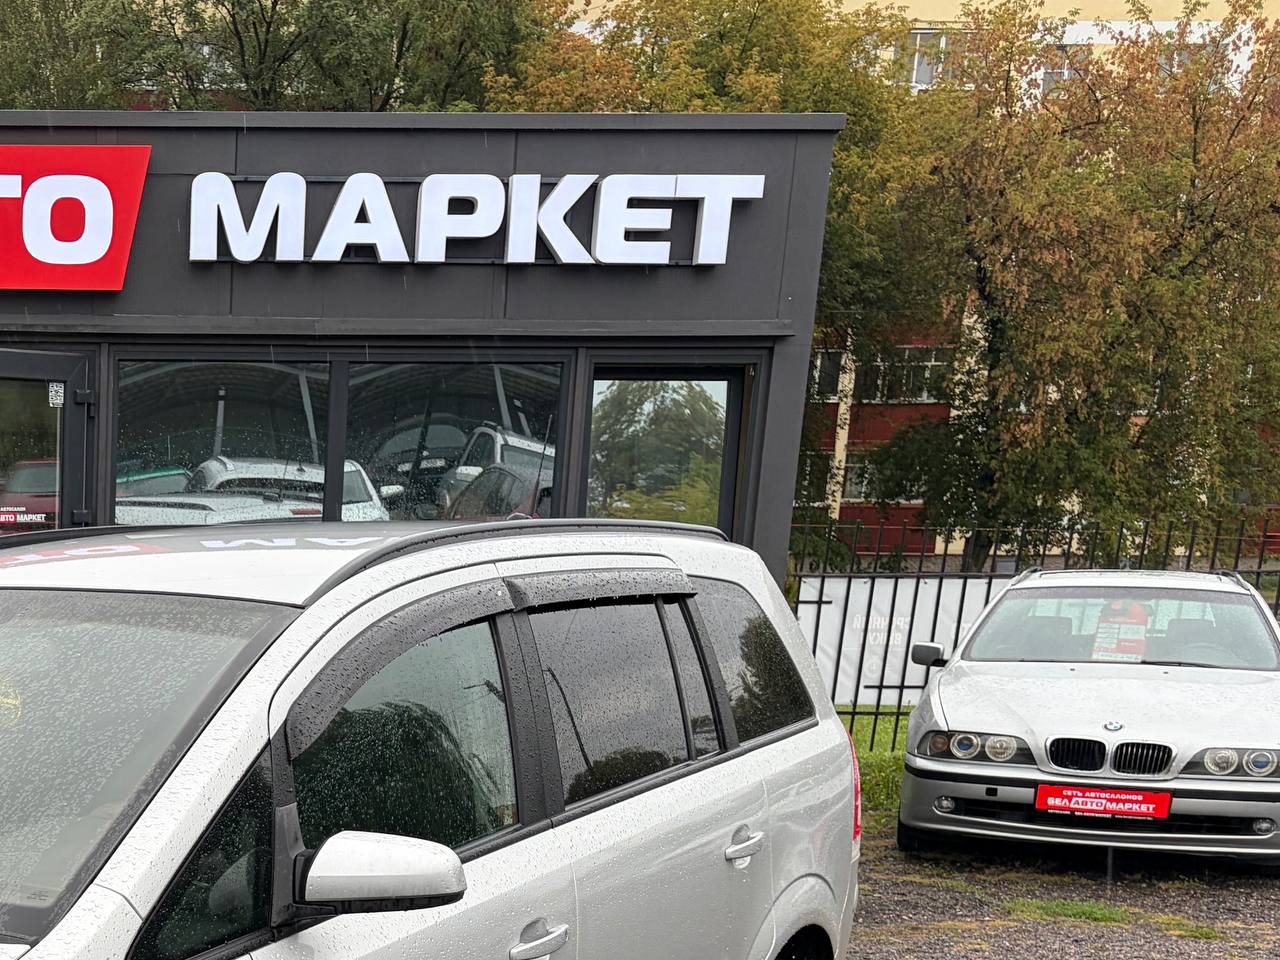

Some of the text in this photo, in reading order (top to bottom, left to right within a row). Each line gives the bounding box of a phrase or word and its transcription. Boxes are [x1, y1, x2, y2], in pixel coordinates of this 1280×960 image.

[189, 171, 766, 266] МАРКЕТ
[16, 513, 47, 523] МАРКЕТ
[1062, 789, 1082, 797] СЕТЬ
[1047, 797, 1156, 812] БЕЛ АВТО МАРКЕТ
